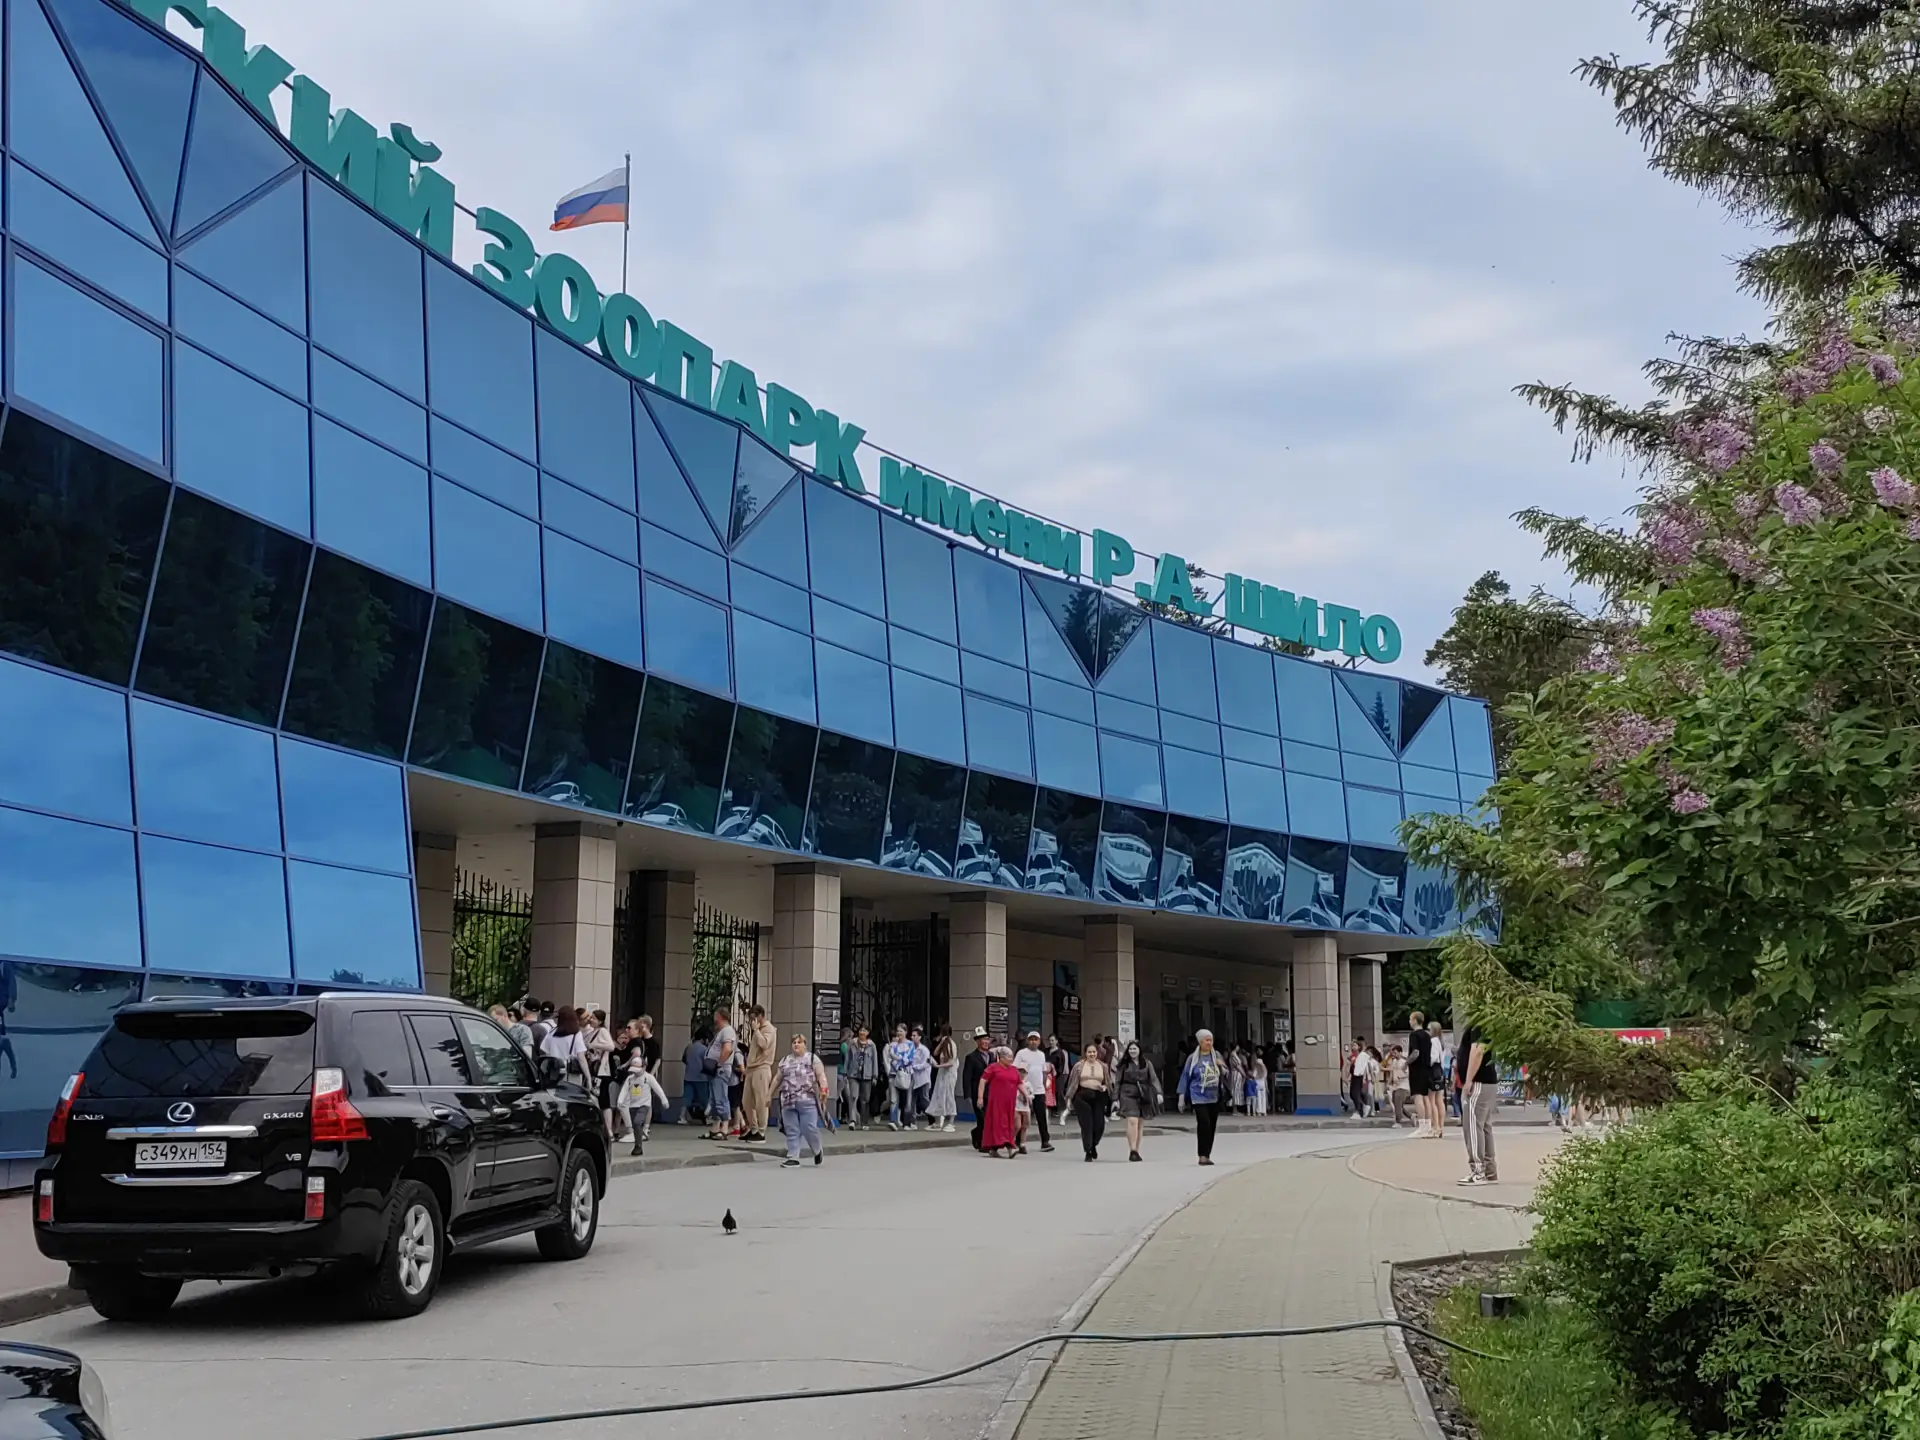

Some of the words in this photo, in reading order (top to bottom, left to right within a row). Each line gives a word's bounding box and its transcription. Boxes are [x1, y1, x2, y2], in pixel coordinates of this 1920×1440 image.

[473, 207, 867, 495] ЗООПАРК
[1225, 572, 1402, 664] ШИЛО
[201, 1143, 223, 1155] 154
